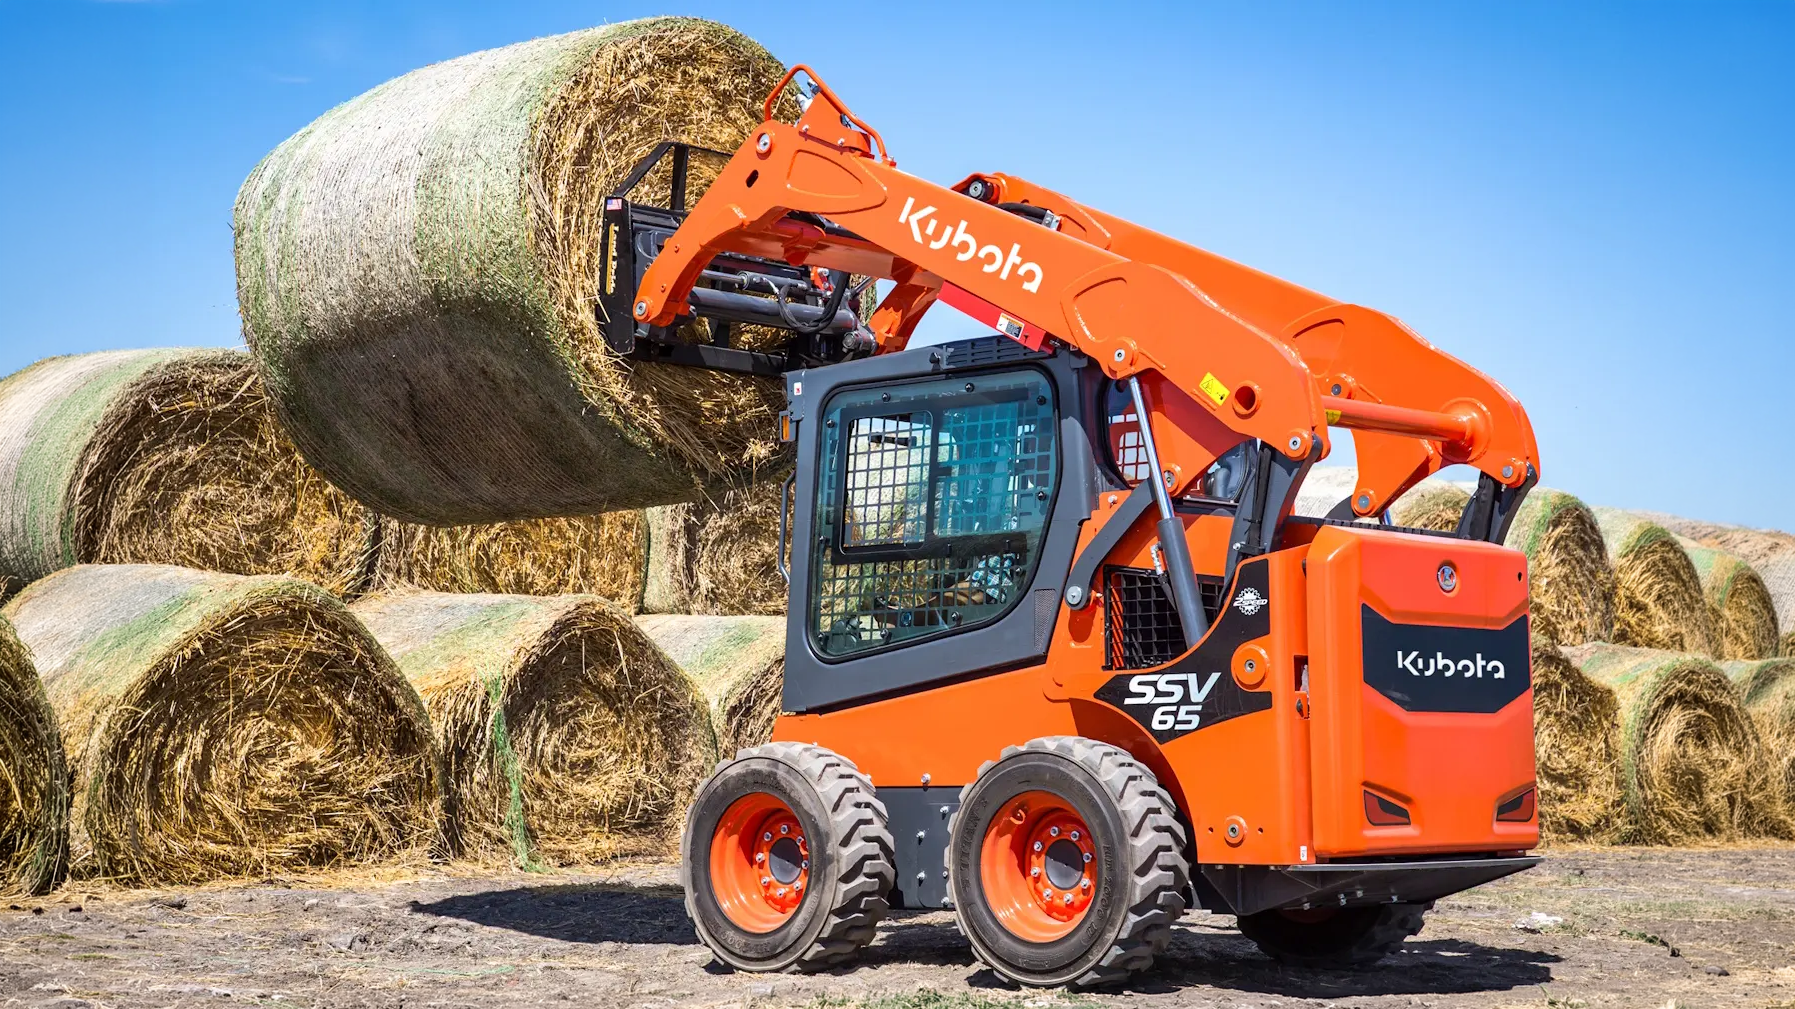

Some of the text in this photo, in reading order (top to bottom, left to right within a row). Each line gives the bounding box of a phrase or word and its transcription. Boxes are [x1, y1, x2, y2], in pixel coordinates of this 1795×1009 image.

[898, 196, 1043, 294] Kubota
[1397, 650, 1505, 679] Kubota
[1124, 672, 1222, 705] SSV
[1151, 705, 1202, 731] 65
